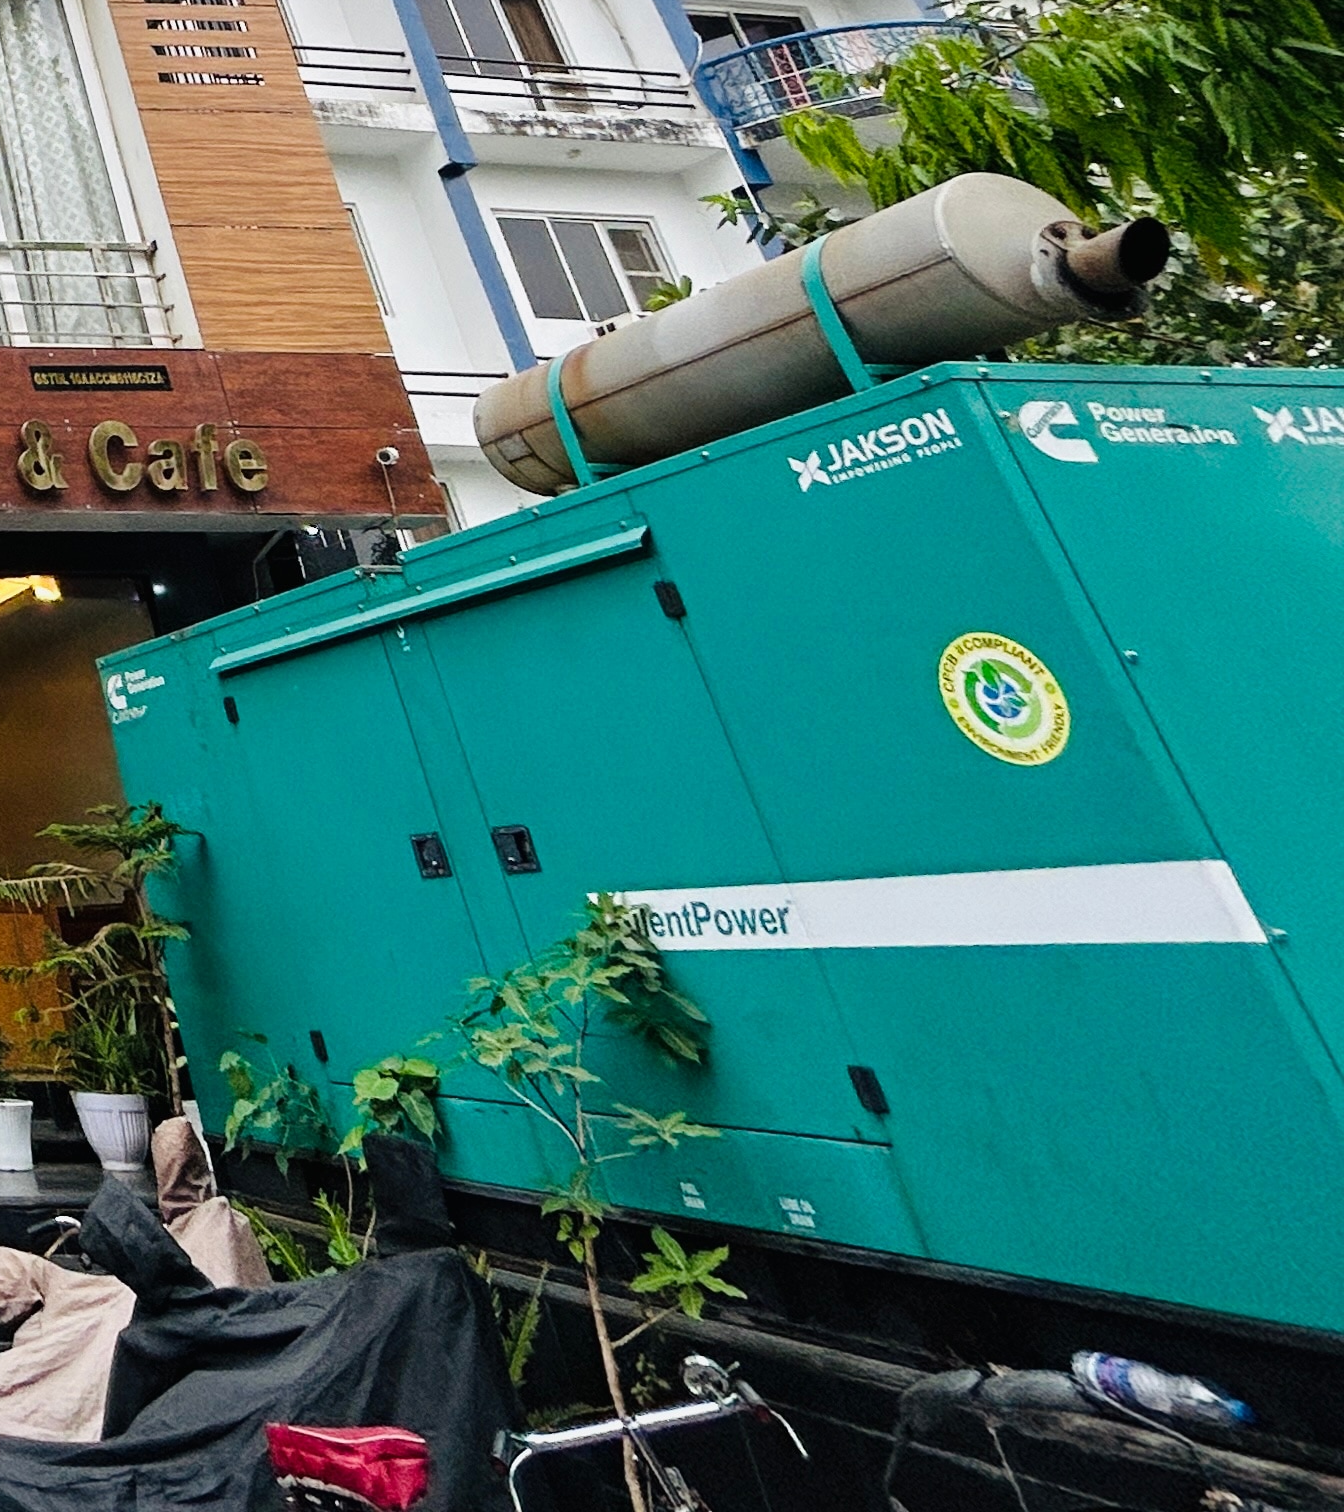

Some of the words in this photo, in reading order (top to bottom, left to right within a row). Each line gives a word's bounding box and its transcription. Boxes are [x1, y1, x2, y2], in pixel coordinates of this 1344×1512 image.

[1087, 401, 1165, 423] Power
[1100, 420, 1238, 445] Generation
[17, 418, 69, 491] &
[88, 419, 269, 492] Cafe
[827, 407, 956, 472] JAKSON
[831, 452, 912, 484] EMPOWERING
[916, 437, 964, 459] PEOPLE
[962, 637, 1046, 676] COMPLIANT
[1039, 702, 1066, 755] FRIENDLY
